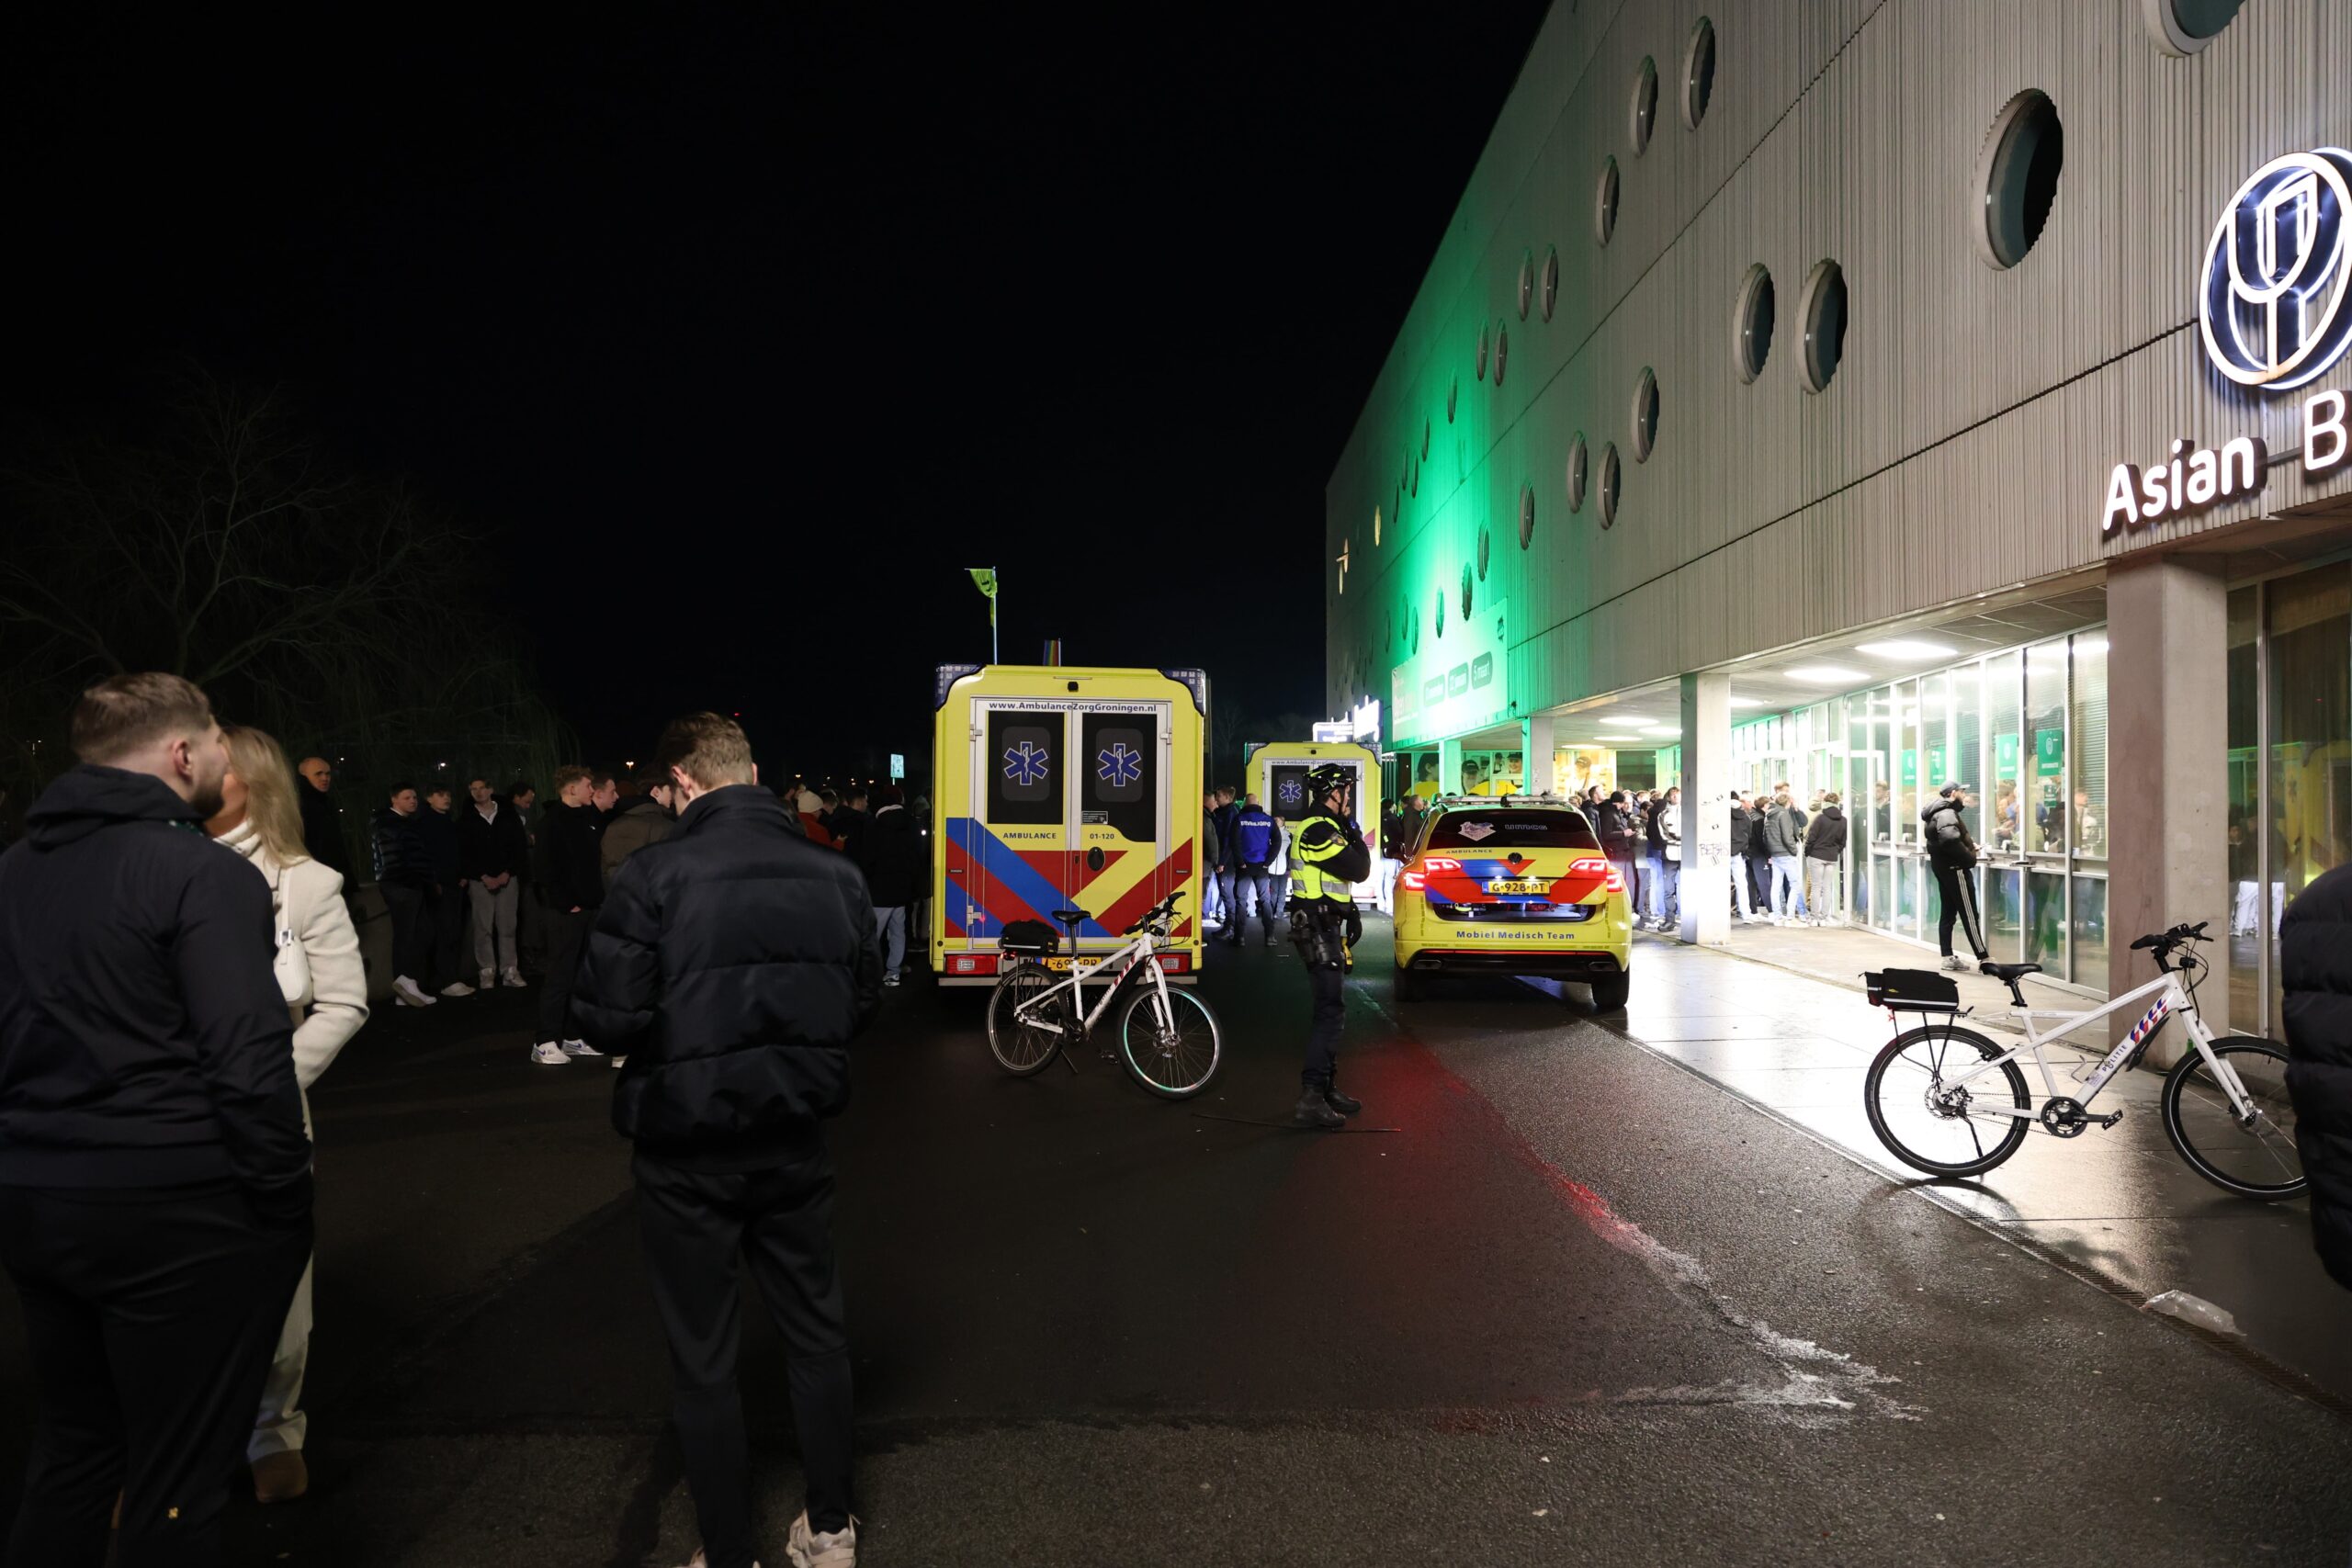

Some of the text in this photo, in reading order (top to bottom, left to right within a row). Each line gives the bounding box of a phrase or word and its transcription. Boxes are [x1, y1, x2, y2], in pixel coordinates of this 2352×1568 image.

[2102, 389, 2347, 532] Asian B
[989, 702, 1157, 713] www.AmbulanceZorgGroningen.nl
[1492, 883, 1545, 892] G-928-PT
[2101, 1044, 2128, 1072] POLITIE
